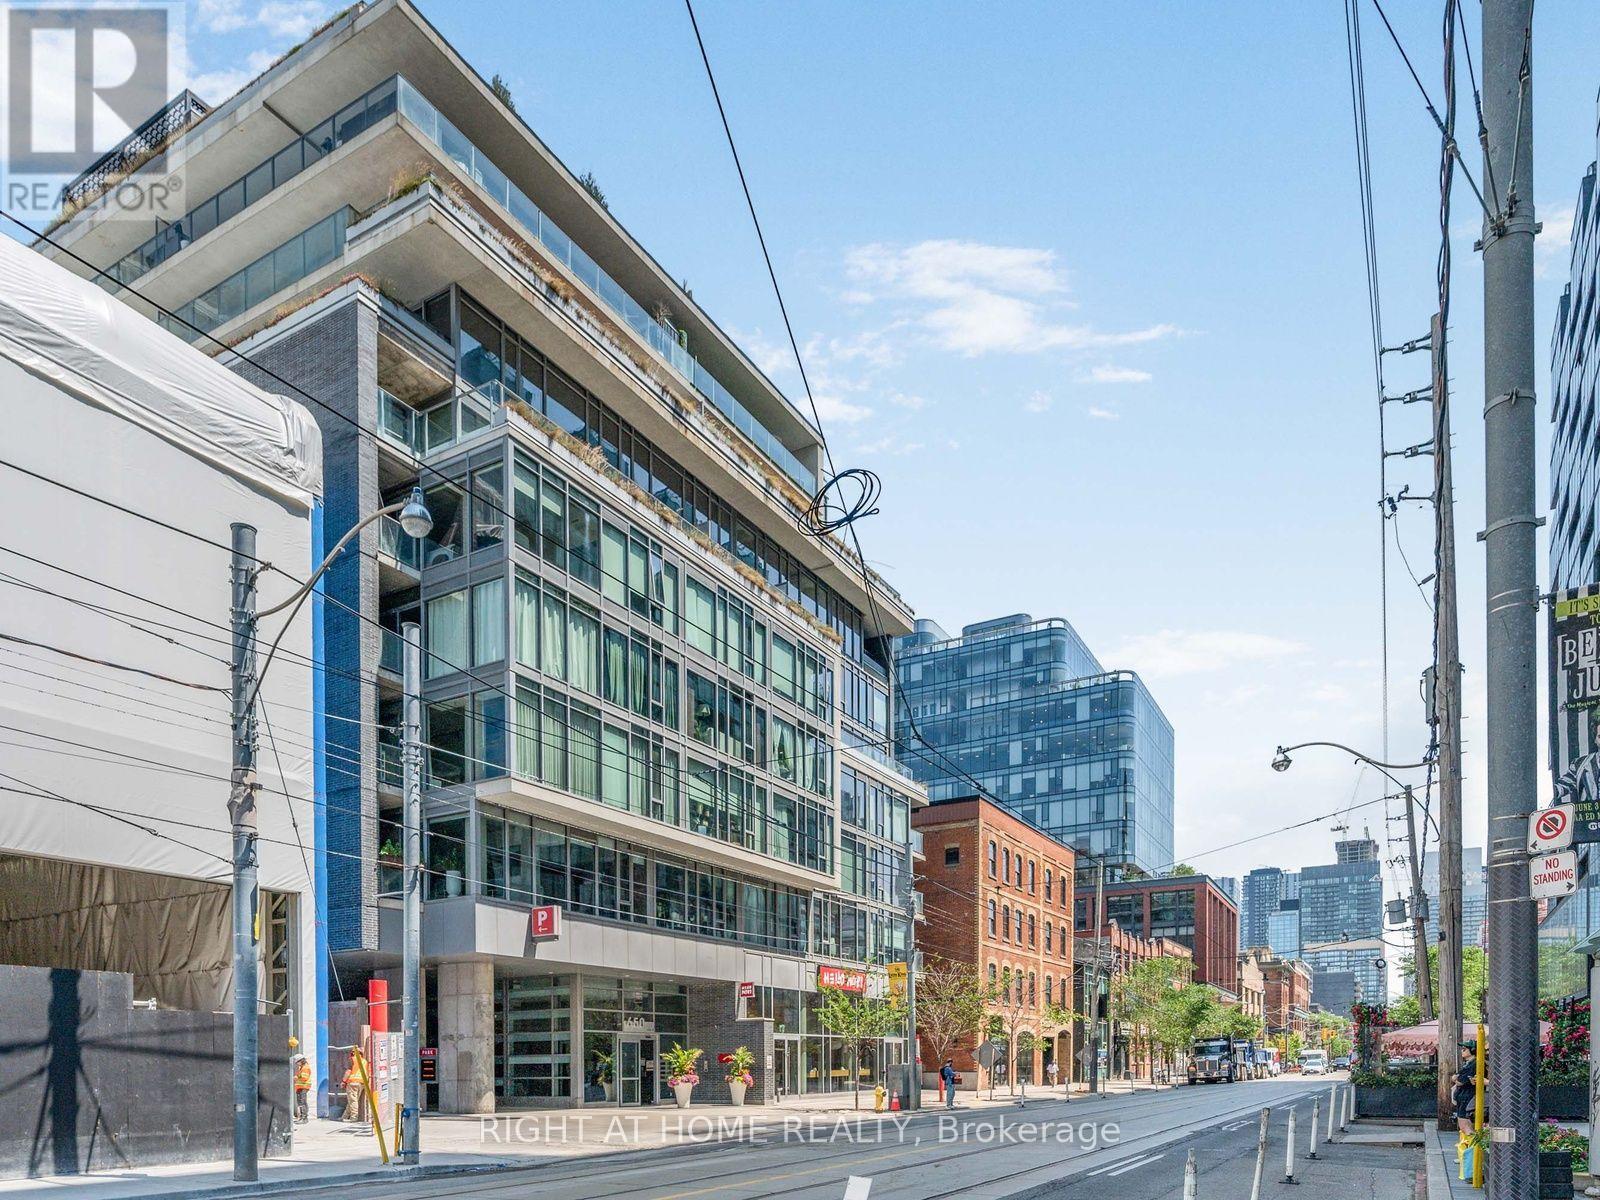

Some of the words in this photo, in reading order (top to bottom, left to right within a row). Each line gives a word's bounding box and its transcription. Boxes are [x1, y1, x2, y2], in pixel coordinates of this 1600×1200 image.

[1569, 599, 1589, 614] IT'S
[1575, 802, 1593, 812] JUNE
[1545, 857, 1560, 870] NO
[1533, 868, 1574, 886] STANDING
[537, 910, 548, 927] P
[627, 1016, 645, 1028] 650
